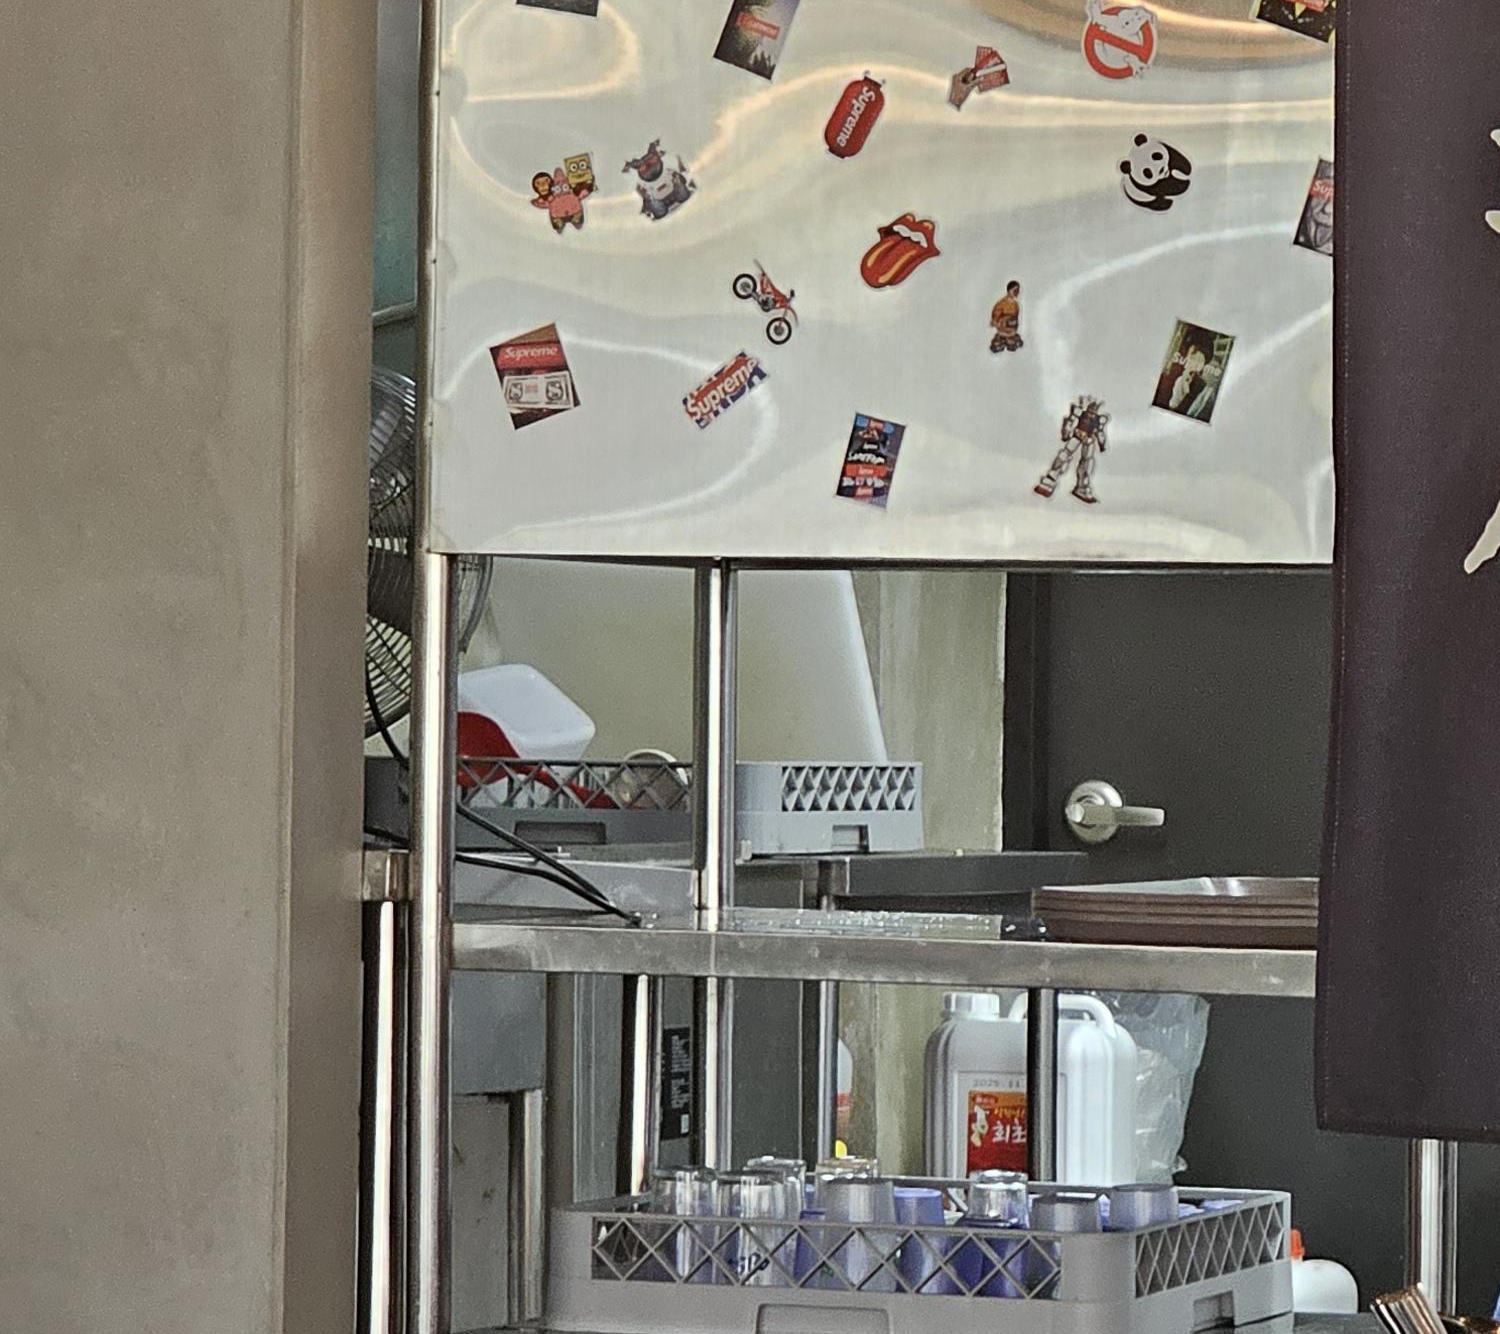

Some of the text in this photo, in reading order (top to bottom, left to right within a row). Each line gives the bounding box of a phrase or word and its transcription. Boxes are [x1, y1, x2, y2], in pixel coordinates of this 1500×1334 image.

[836, 85, 877, 148] Supreme
[504, 344, 559, 361] Supreme
[686, 357, 759, 422] Supreme
